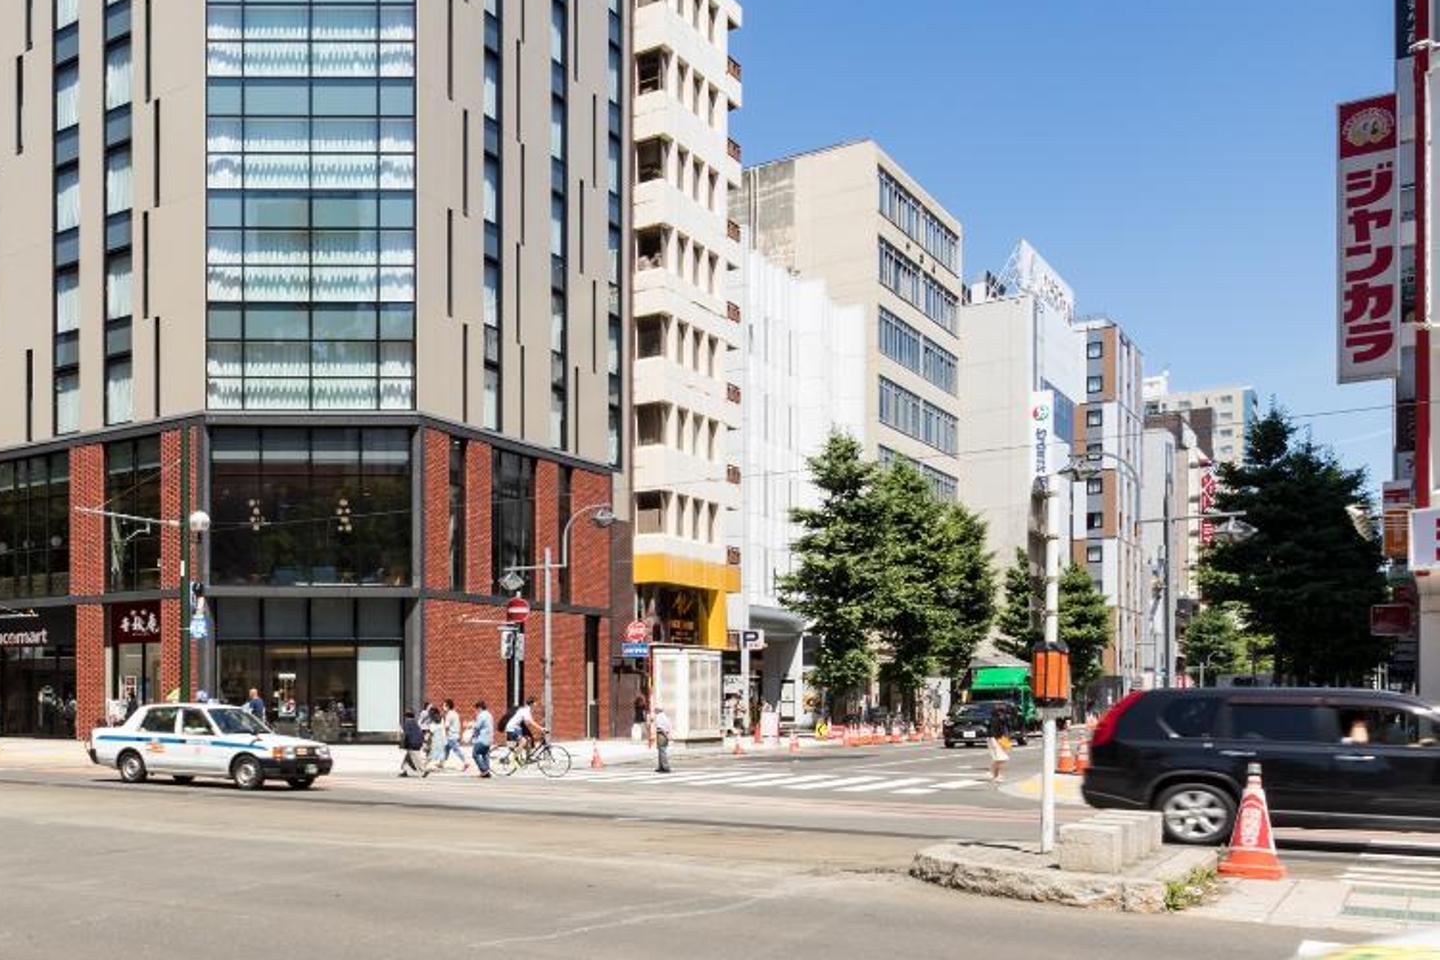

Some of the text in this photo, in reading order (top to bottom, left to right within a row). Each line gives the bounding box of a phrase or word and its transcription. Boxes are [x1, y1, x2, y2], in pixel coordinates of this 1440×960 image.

[1343, 161, 1394, 364] ジャンカラ
[742, 631, 759, 649] P
